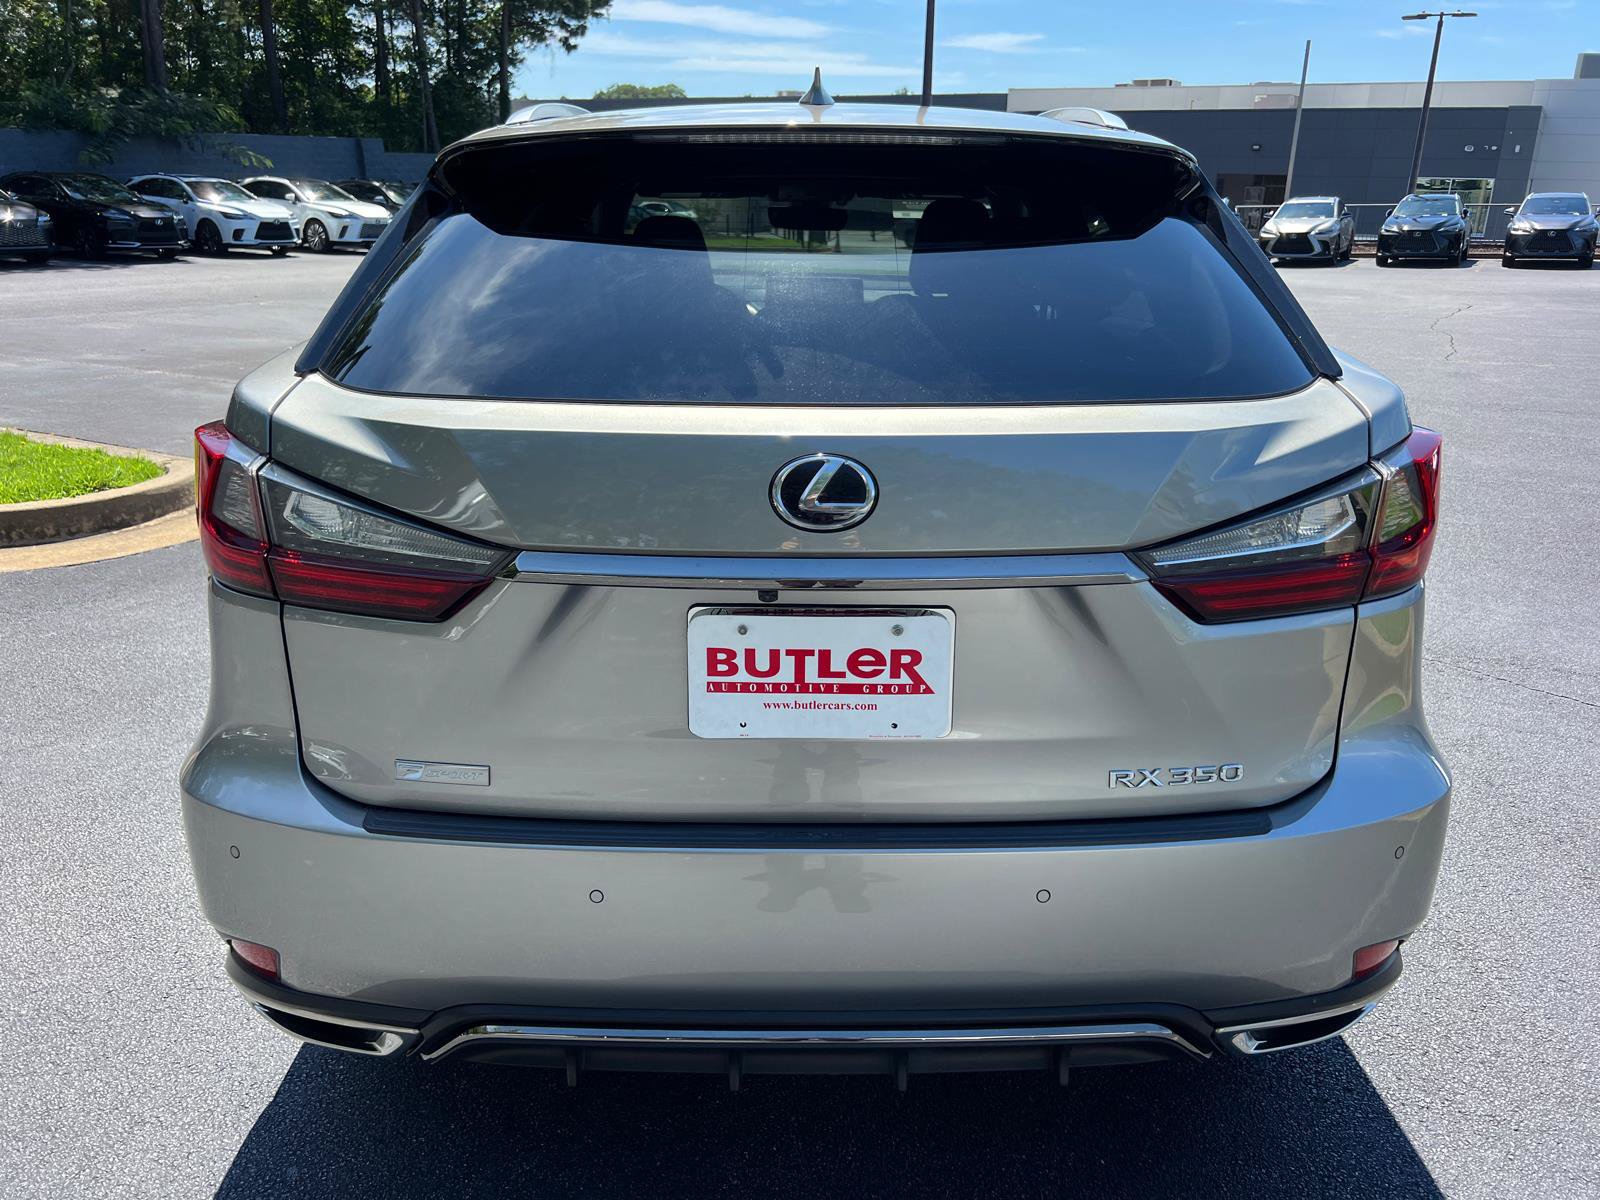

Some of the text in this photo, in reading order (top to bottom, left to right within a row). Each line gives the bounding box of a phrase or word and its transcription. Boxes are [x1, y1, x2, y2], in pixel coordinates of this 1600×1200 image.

[707, 683, 927, 693] AUTOMOTIVE GROUP
[762, 700, 878, 712] www.butlercars.com
[1109, 763, 1244, 789] RX 350
